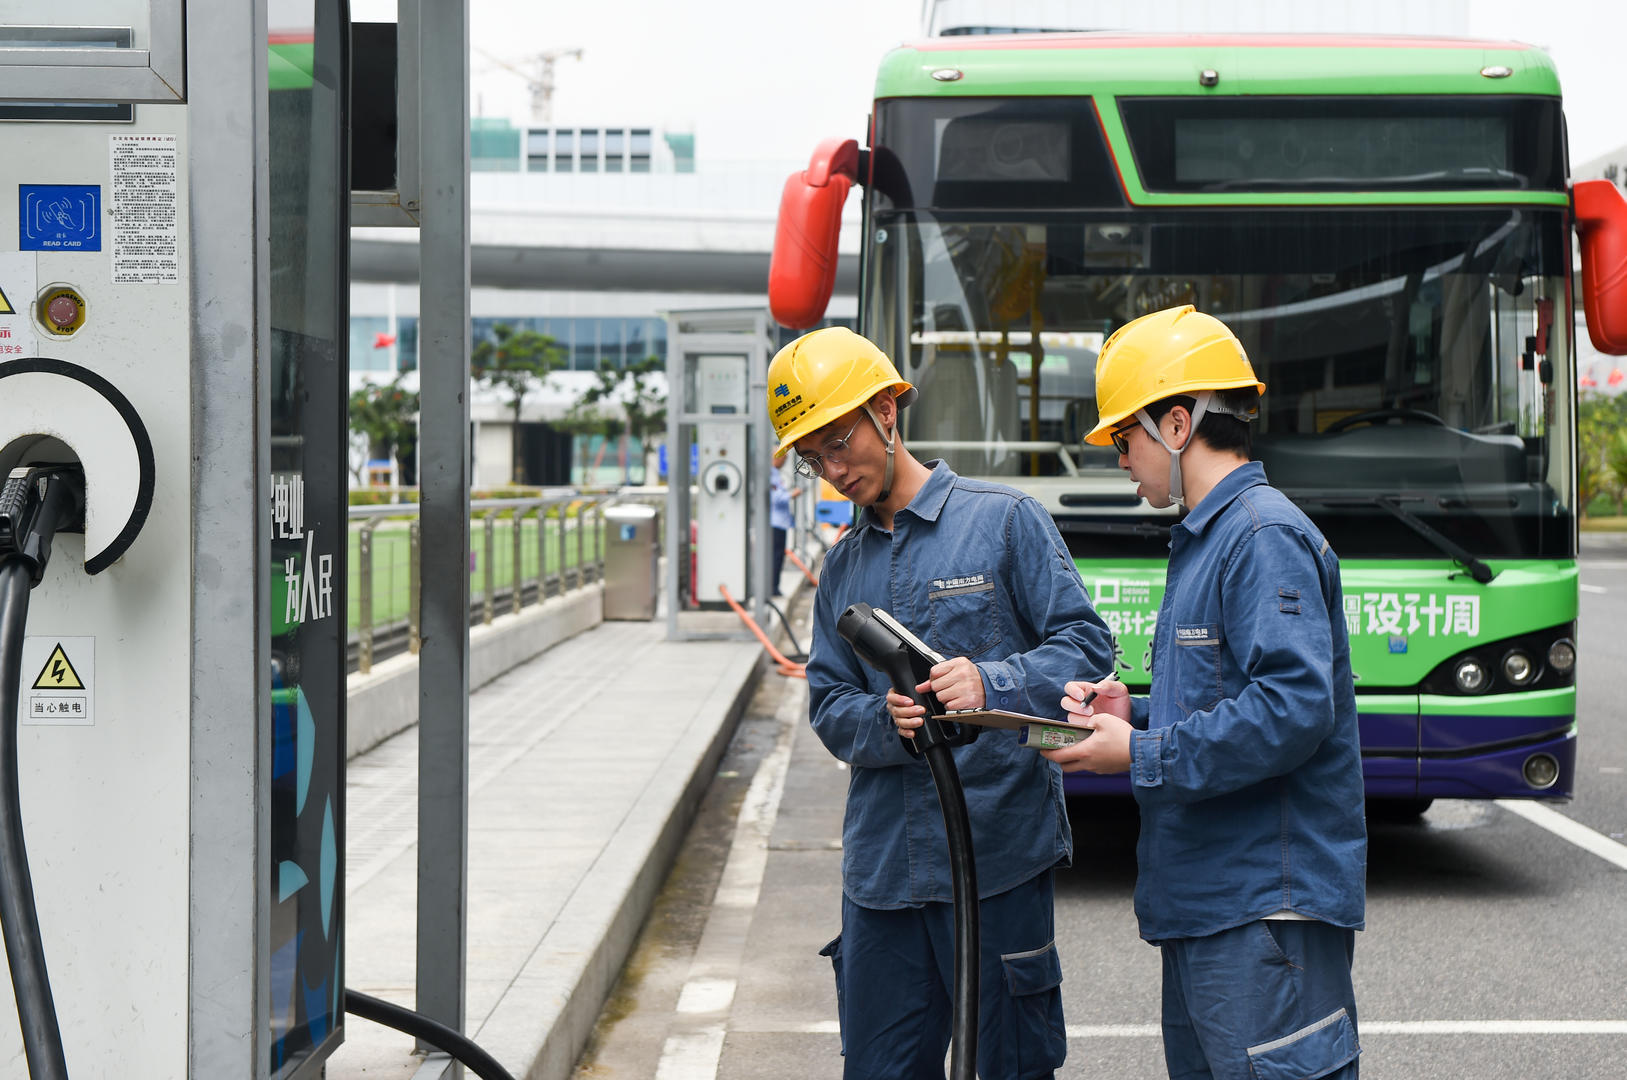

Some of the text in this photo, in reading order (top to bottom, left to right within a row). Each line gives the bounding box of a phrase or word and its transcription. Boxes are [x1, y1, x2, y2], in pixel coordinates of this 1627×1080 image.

[285, 530, 332, 624] 为人民
[945, 574, 984, 587] 中国南方电网
[1122, 587, 1150, 595] DESIGN
[1122, 596, 1150, 604] WEEK
[34, 702, 82, 713] 当心触电
